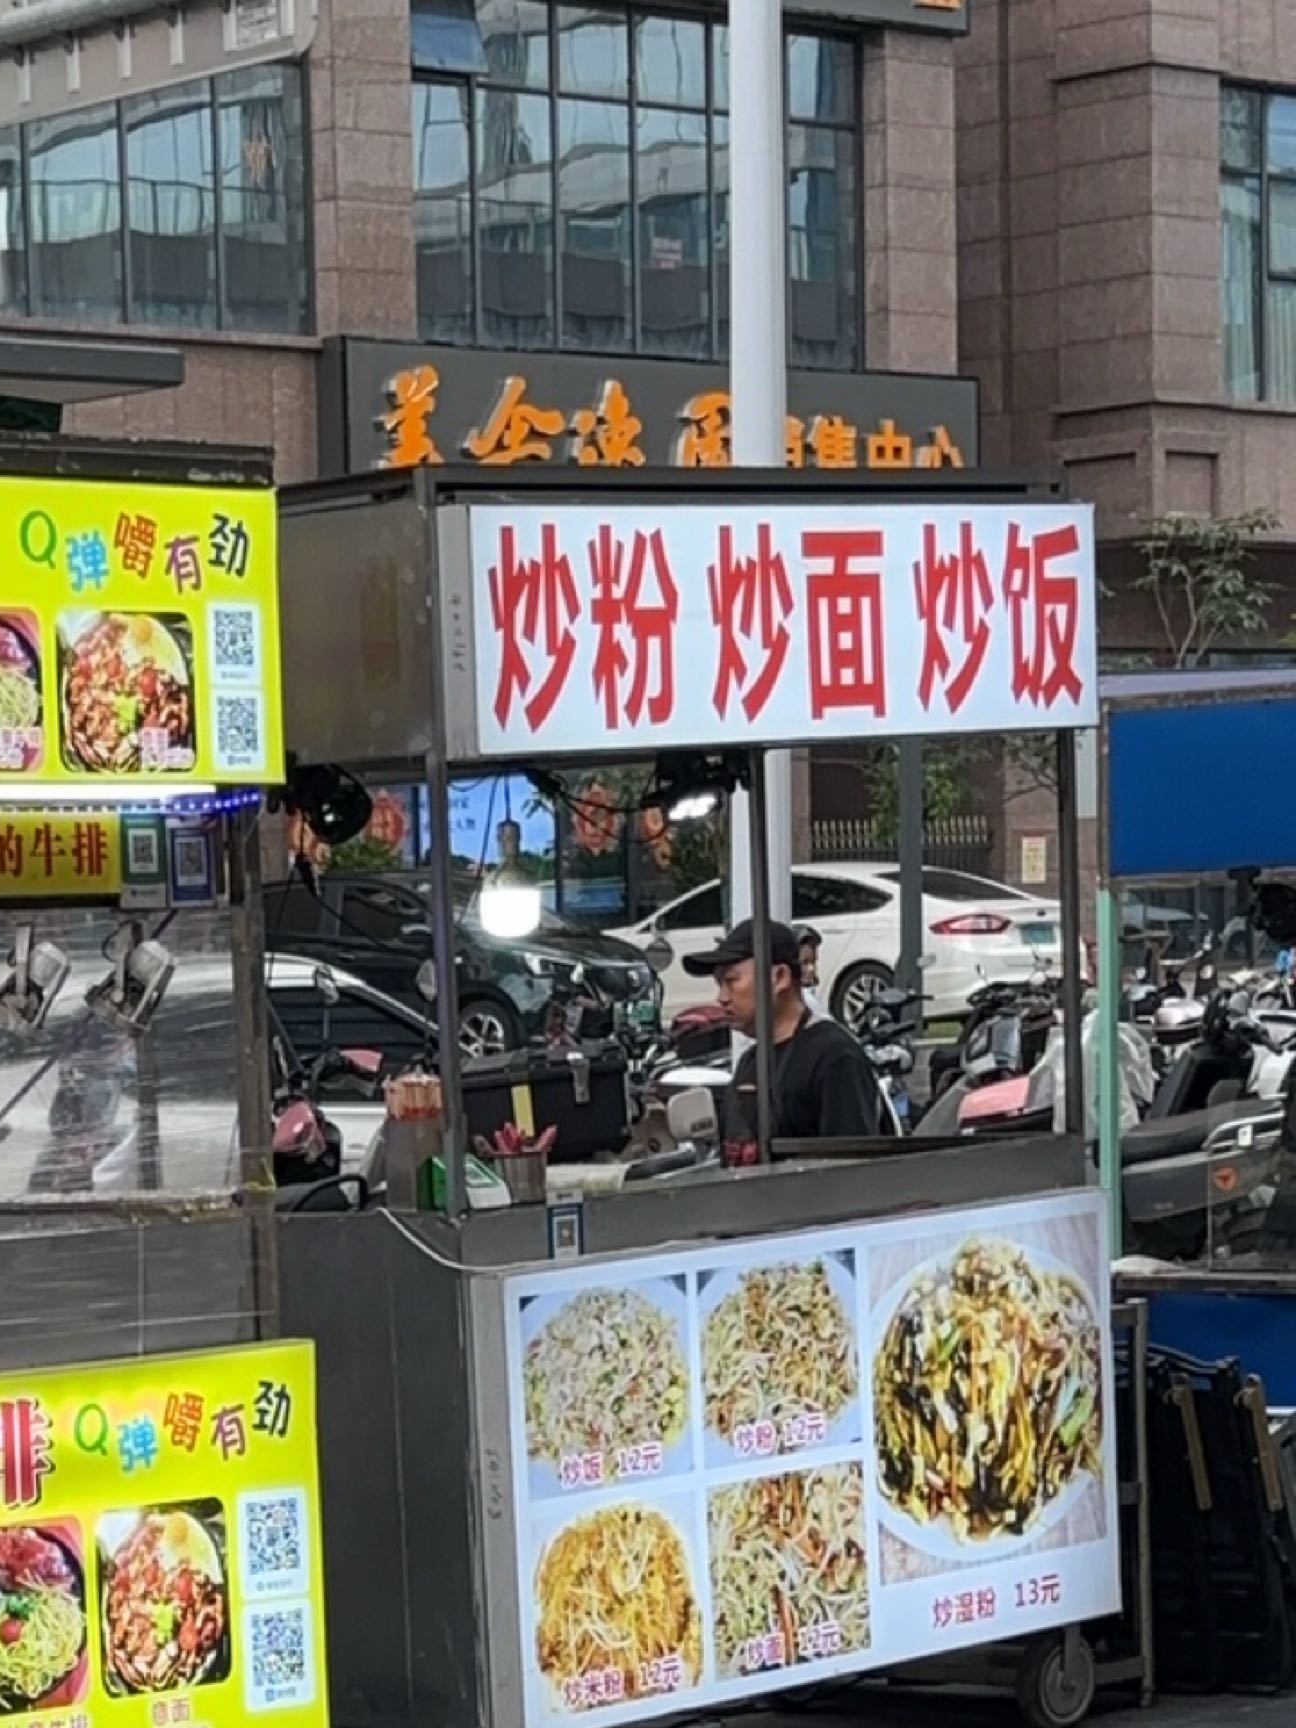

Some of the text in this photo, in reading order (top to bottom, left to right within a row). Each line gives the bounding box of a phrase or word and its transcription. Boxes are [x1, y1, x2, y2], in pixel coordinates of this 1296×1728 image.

[19, 510, 250, 595] Q弹嚼有劲
[488, 521, 678, 732] 炒粉
[707, 521, 886, 723] 炒面
[912, 519, 1084, 715] 炒饭
[73, 1380, 292, 1472] Q弹嚼有劲
[735, 1413, 824, 1453] 炒粉 12元
[561, 1443, 661, 1486] 炒饭 12元
[932, 1574, 1062, 1629] 炒湿粉 13元
[747, 1622, 841, 1667] 炒面 12元
[563, 1656, 682, 1707] 炒米粉 12元
